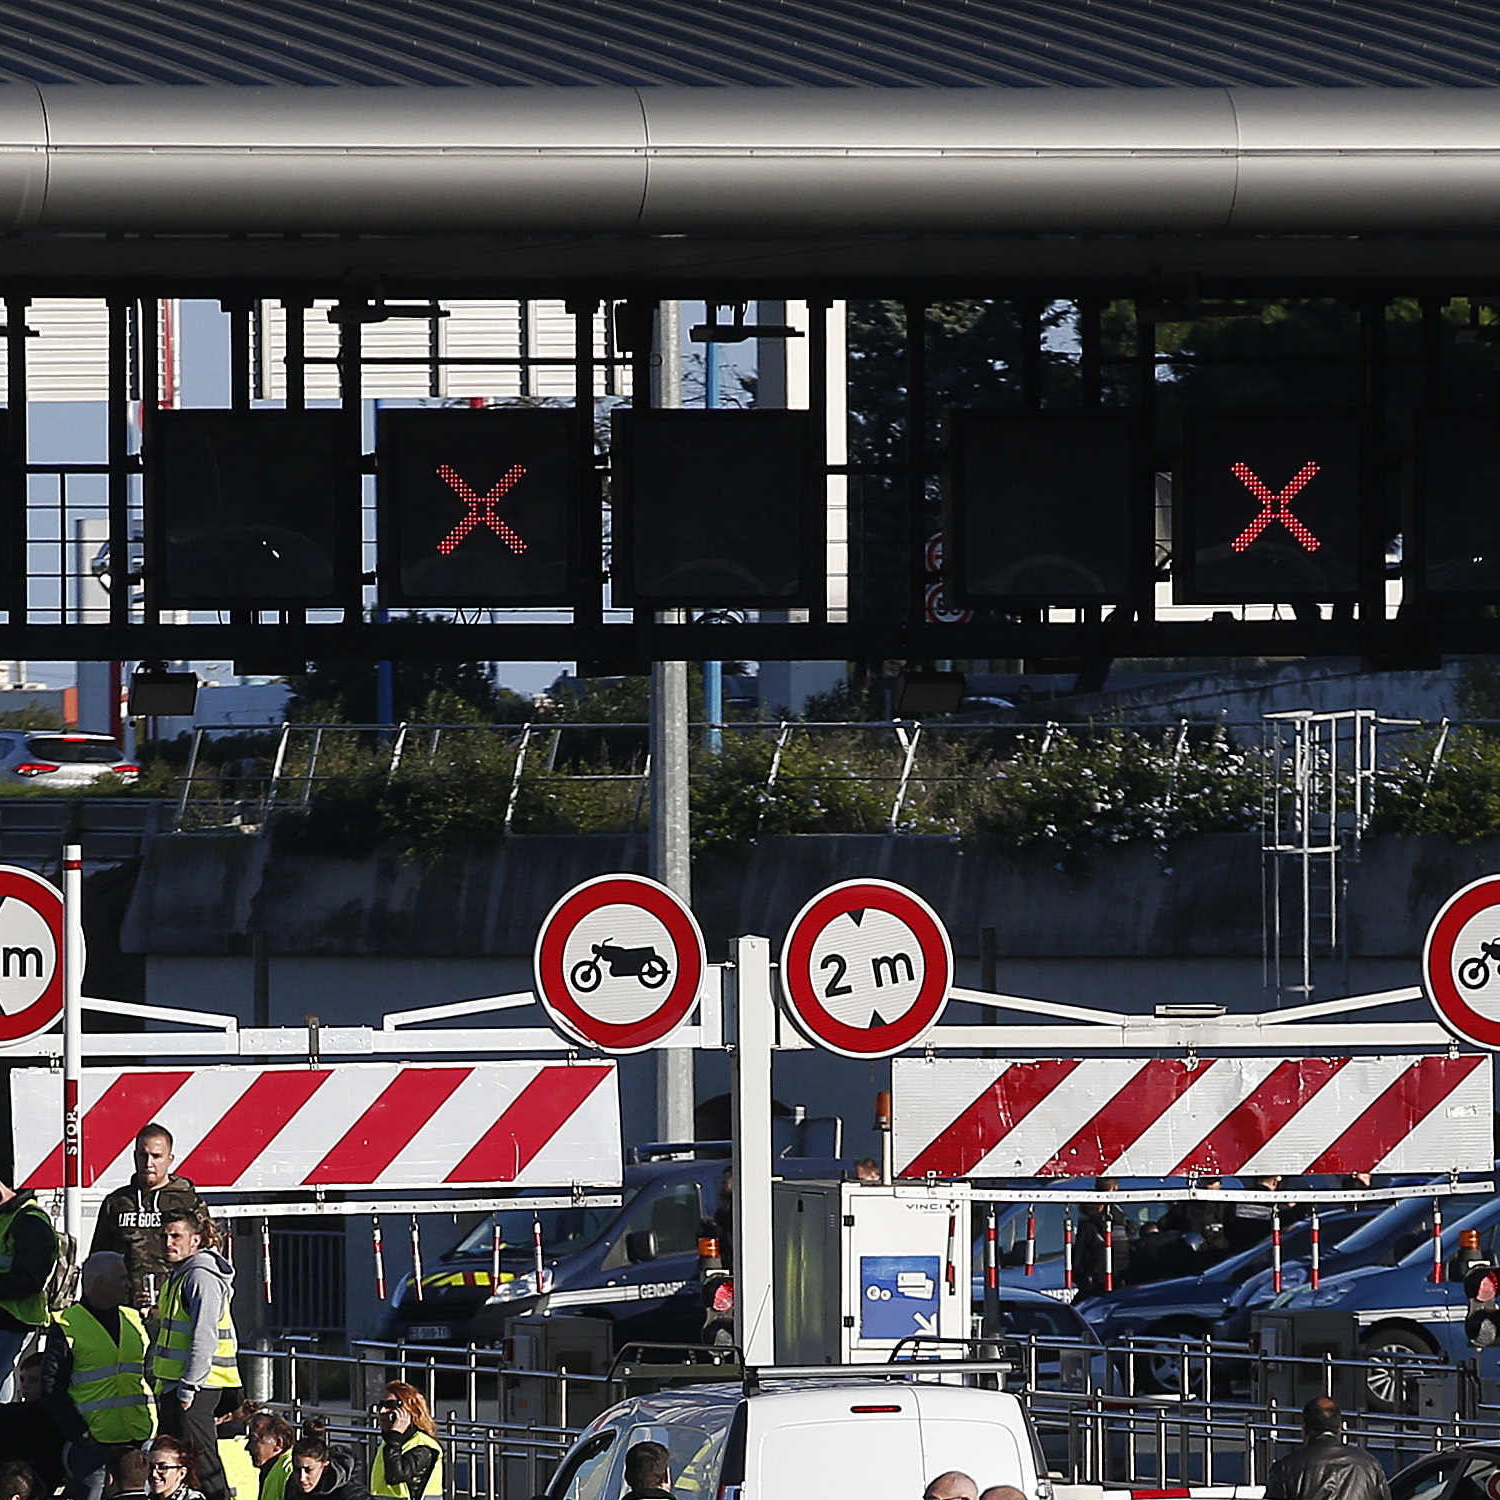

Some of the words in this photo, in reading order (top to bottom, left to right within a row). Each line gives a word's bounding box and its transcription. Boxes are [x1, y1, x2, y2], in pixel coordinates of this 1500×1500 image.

[2, 947, 43, 977] m
[820, 953, 852, 998] 2
[871, 952, 915, 988] m
[66, 1111, 78, 1156] STOP
[118, 1212, 137, 1227] LIFE
[138, 1212, 162, 1228] GOES
